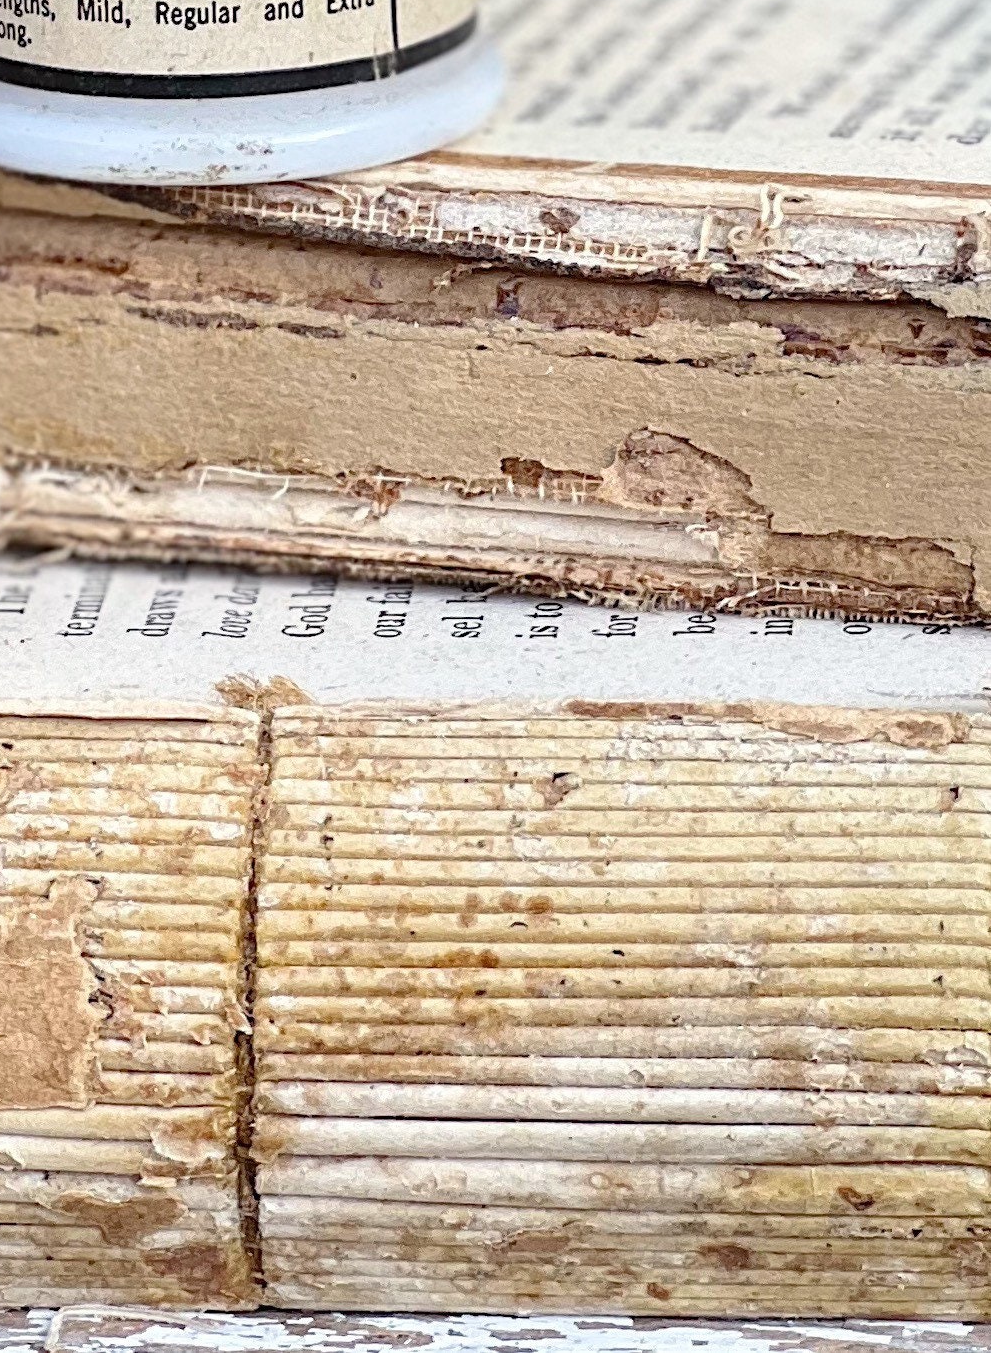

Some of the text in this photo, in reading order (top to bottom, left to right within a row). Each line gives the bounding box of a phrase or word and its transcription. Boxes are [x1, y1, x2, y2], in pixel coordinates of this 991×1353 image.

[155, 1, 241, 31] Regular
[126, 589, 184, 637] draws
[201, 609, 253, 638] love
[281, 604, 332, 638] God
[374, 610, 408, 639] our
[441, 614, 484, 639] sel
[514, 601, 564, 639] is to
[592, 614, 639, 637] for
